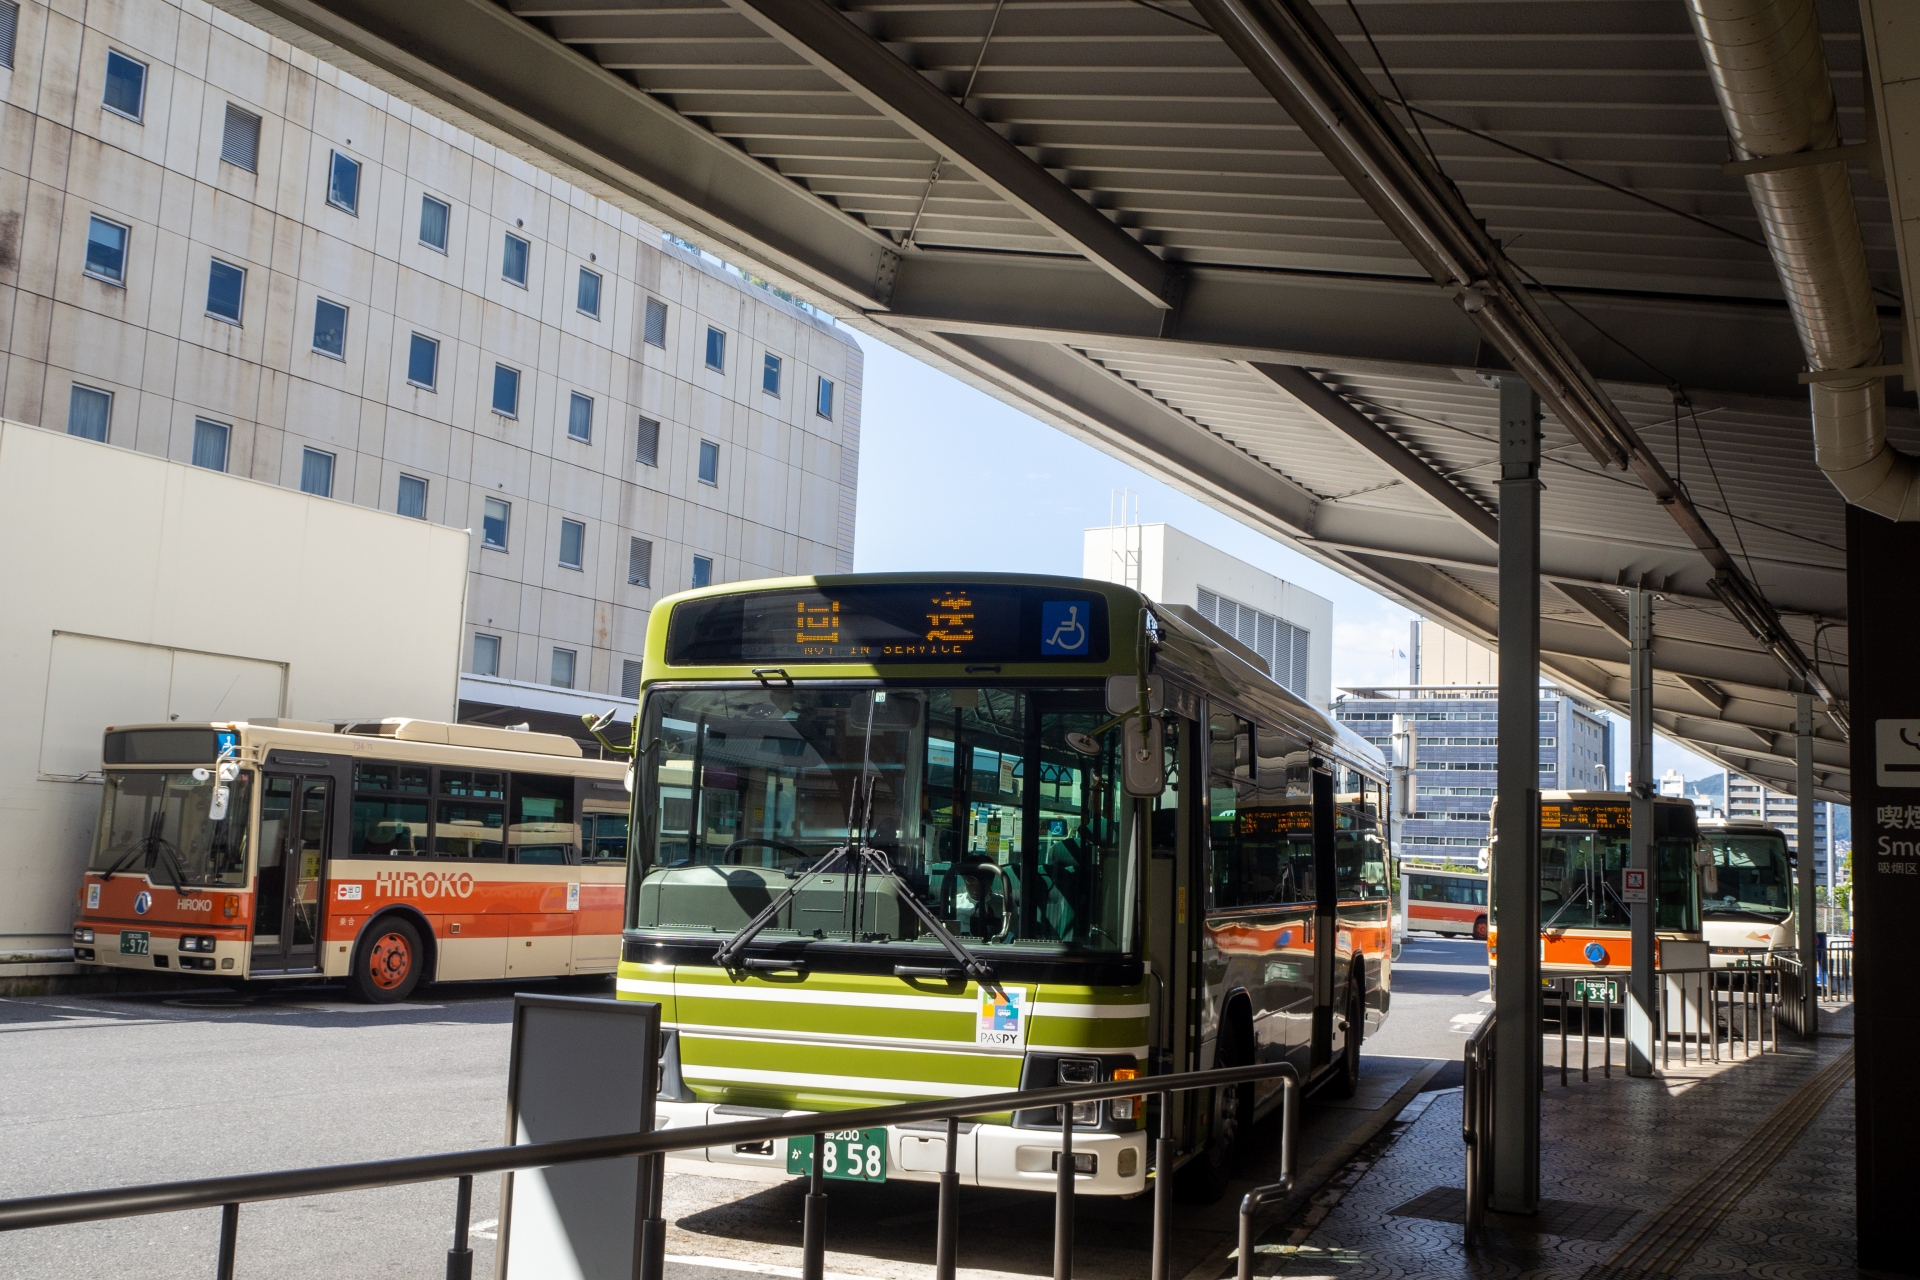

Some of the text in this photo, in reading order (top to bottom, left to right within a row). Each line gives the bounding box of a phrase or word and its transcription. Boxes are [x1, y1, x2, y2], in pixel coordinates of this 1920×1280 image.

[1877, 862, 1918, 875] 吸烟区
[375, 871, 474, 899] HIROKO
[177, 899, 213, 912] HIROKO
[1473, 906, 1488, 914] HIRO
[980, 1032, 1018, 1045] PASPY
